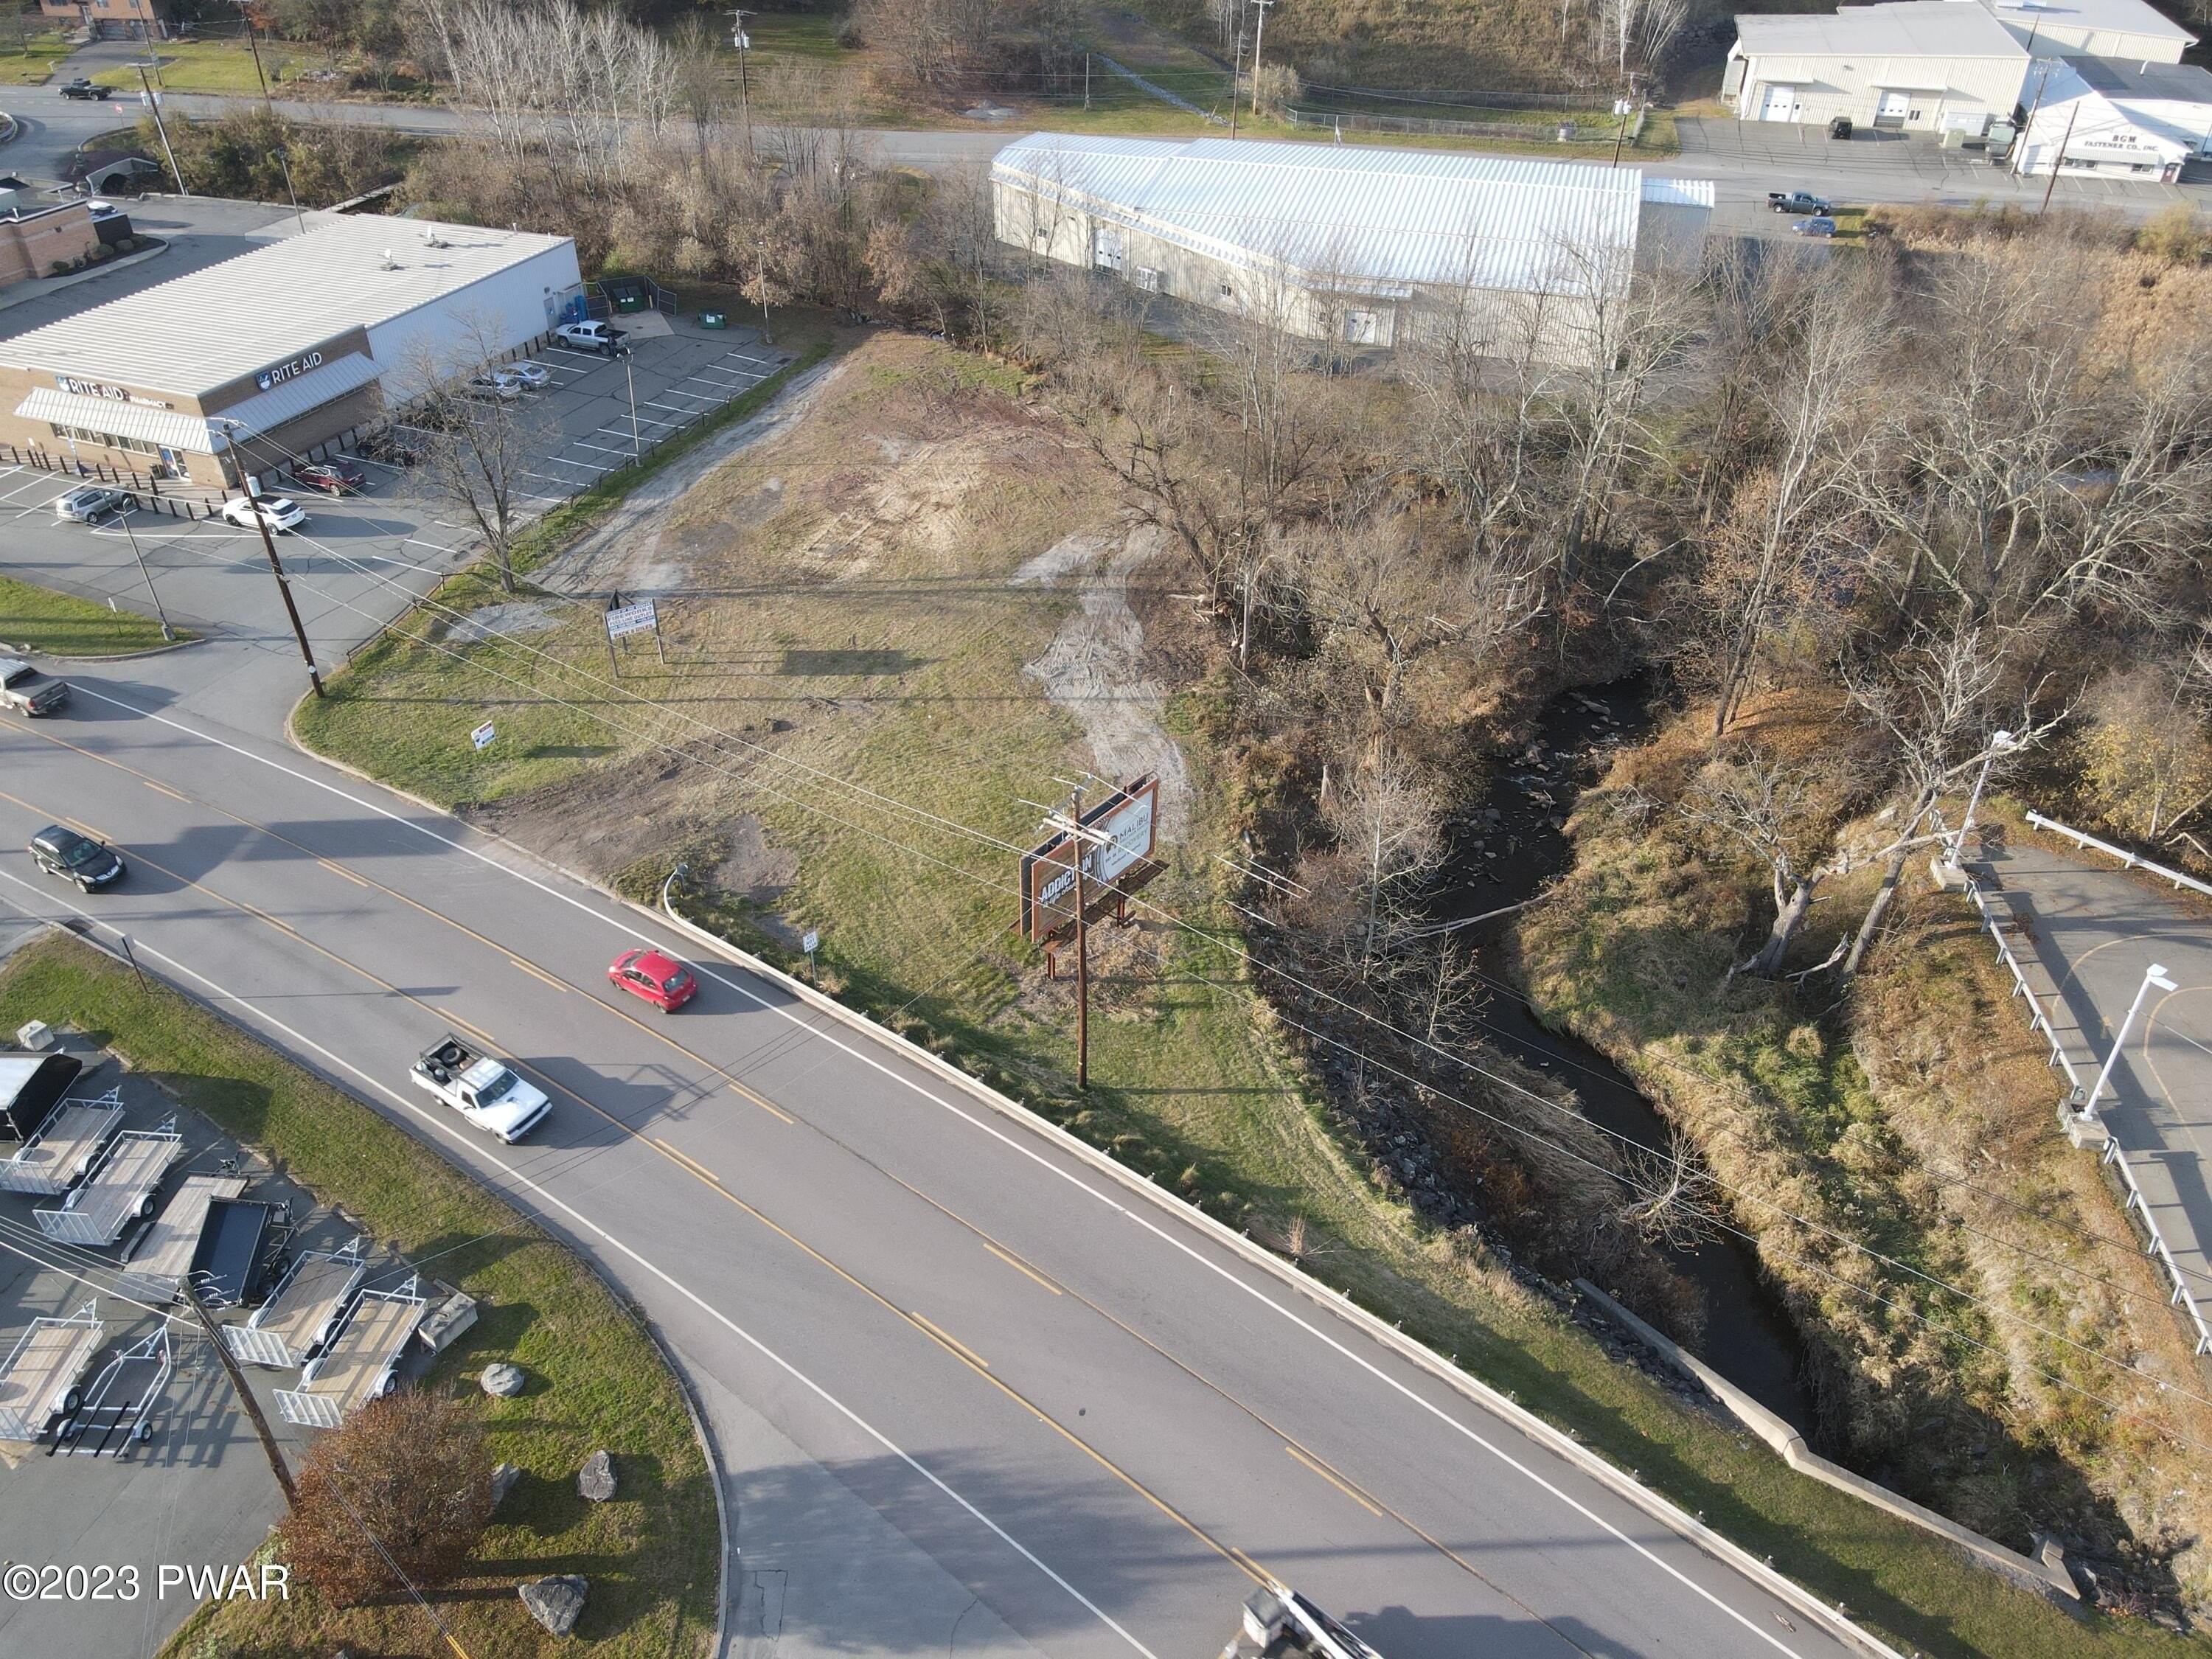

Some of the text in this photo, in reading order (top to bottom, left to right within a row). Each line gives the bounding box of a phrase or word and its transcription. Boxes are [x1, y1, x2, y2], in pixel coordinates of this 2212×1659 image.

[2084, 141, 2124, 149] FASTENER
[271, 352, 322, 383] RITE AID
[69, 378, 124, 400] RITE AID
[130, 395, 166, 408] PHARMACY
[608, 606, 653, 622] FIREWORKS
[636, 624, 653, 633] MILES
[1120, 812, 1149, 839] MALIBU
[806, 942, 816, 950] PASS
